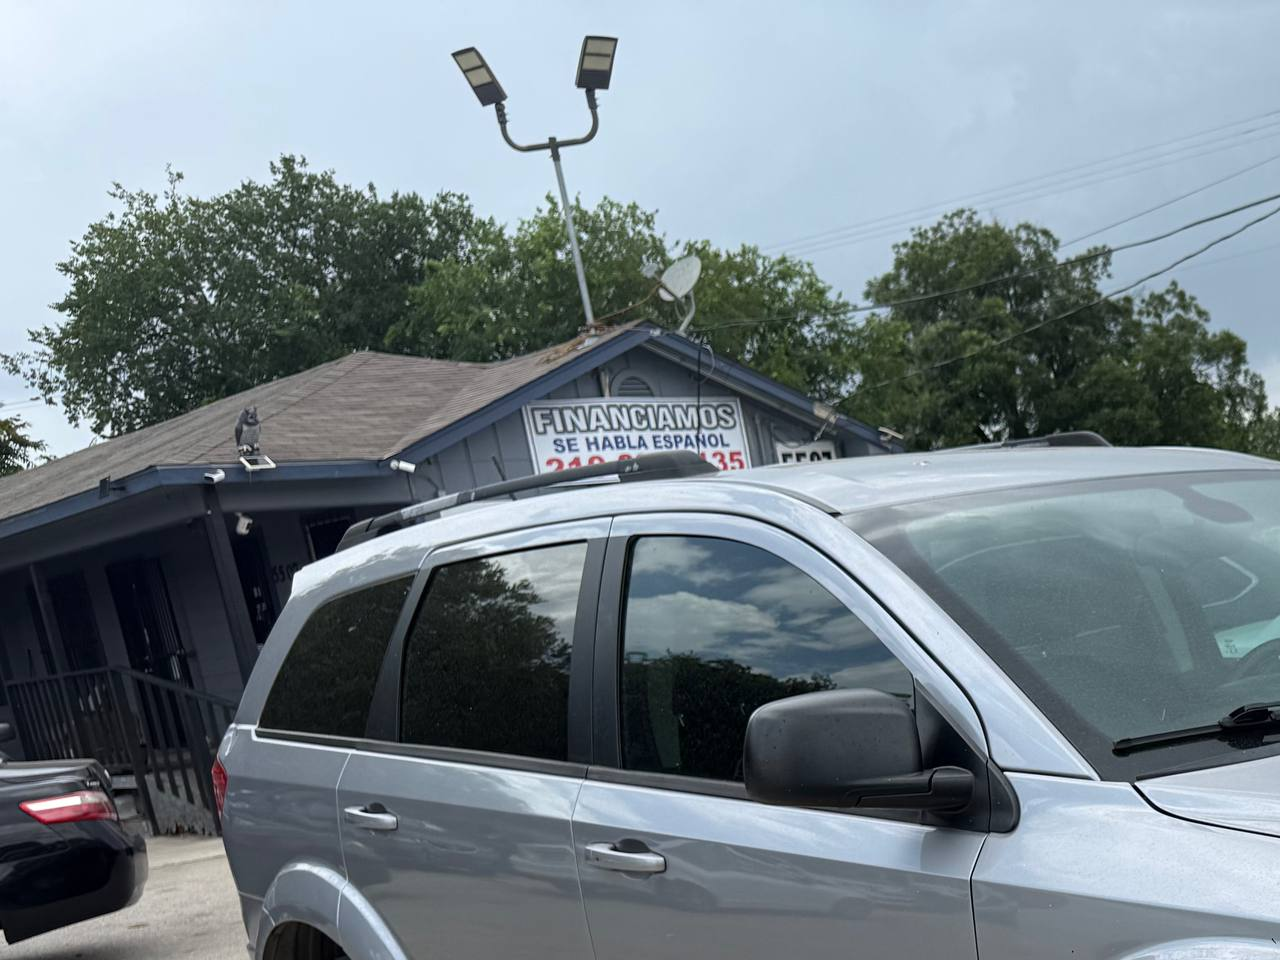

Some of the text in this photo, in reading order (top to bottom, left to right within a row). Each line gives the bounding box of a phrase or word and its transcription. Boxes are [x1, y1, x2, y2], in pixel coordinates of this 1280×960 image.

[530, 404, 738, 435] FINANCIAMOS
[553, 438, 579, 453] SE
[585, 435, 648, 451] HABLA
